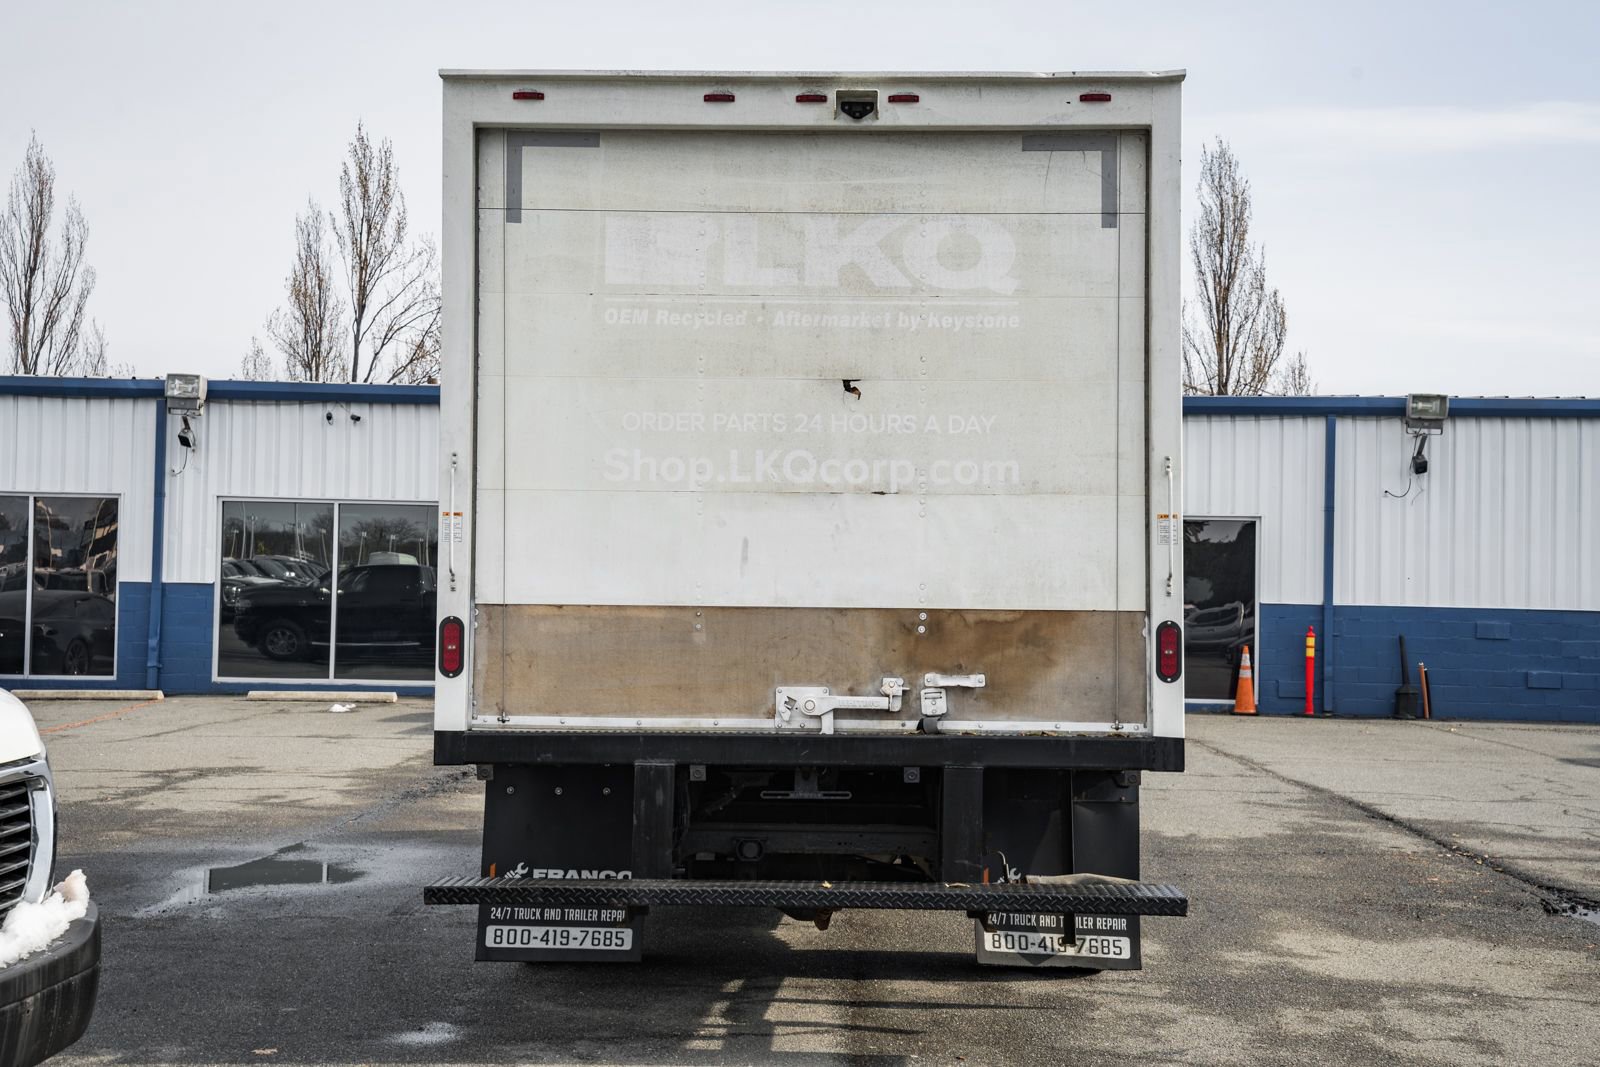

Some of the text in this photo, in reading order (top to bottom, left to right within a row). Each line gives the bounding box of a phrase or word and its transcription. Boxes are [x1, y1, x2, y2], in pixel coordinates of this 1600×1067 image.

[723, 215, 1020, 295] LKQ
[604, 309, 1020, 332] OEM Recycled Aftermarket by Keystone
[622, 412, 997, 435] ORDER PARTS 24 HOURS A DAY
[603, 448, 1020, 494] Shop.LKQcorp.com
[490, 907, 626, 922] 24/7 TRUCK AND TRAILER REPAI
[1009, 914, 1037, 926] TRUCK
[1039, 915, 1056, 928] AND
[1058, 916, 1094, 929] TILER
[1096, 917, 1127, 931] REPAIR
[493, 929, 625, 947] 800-419-7685
